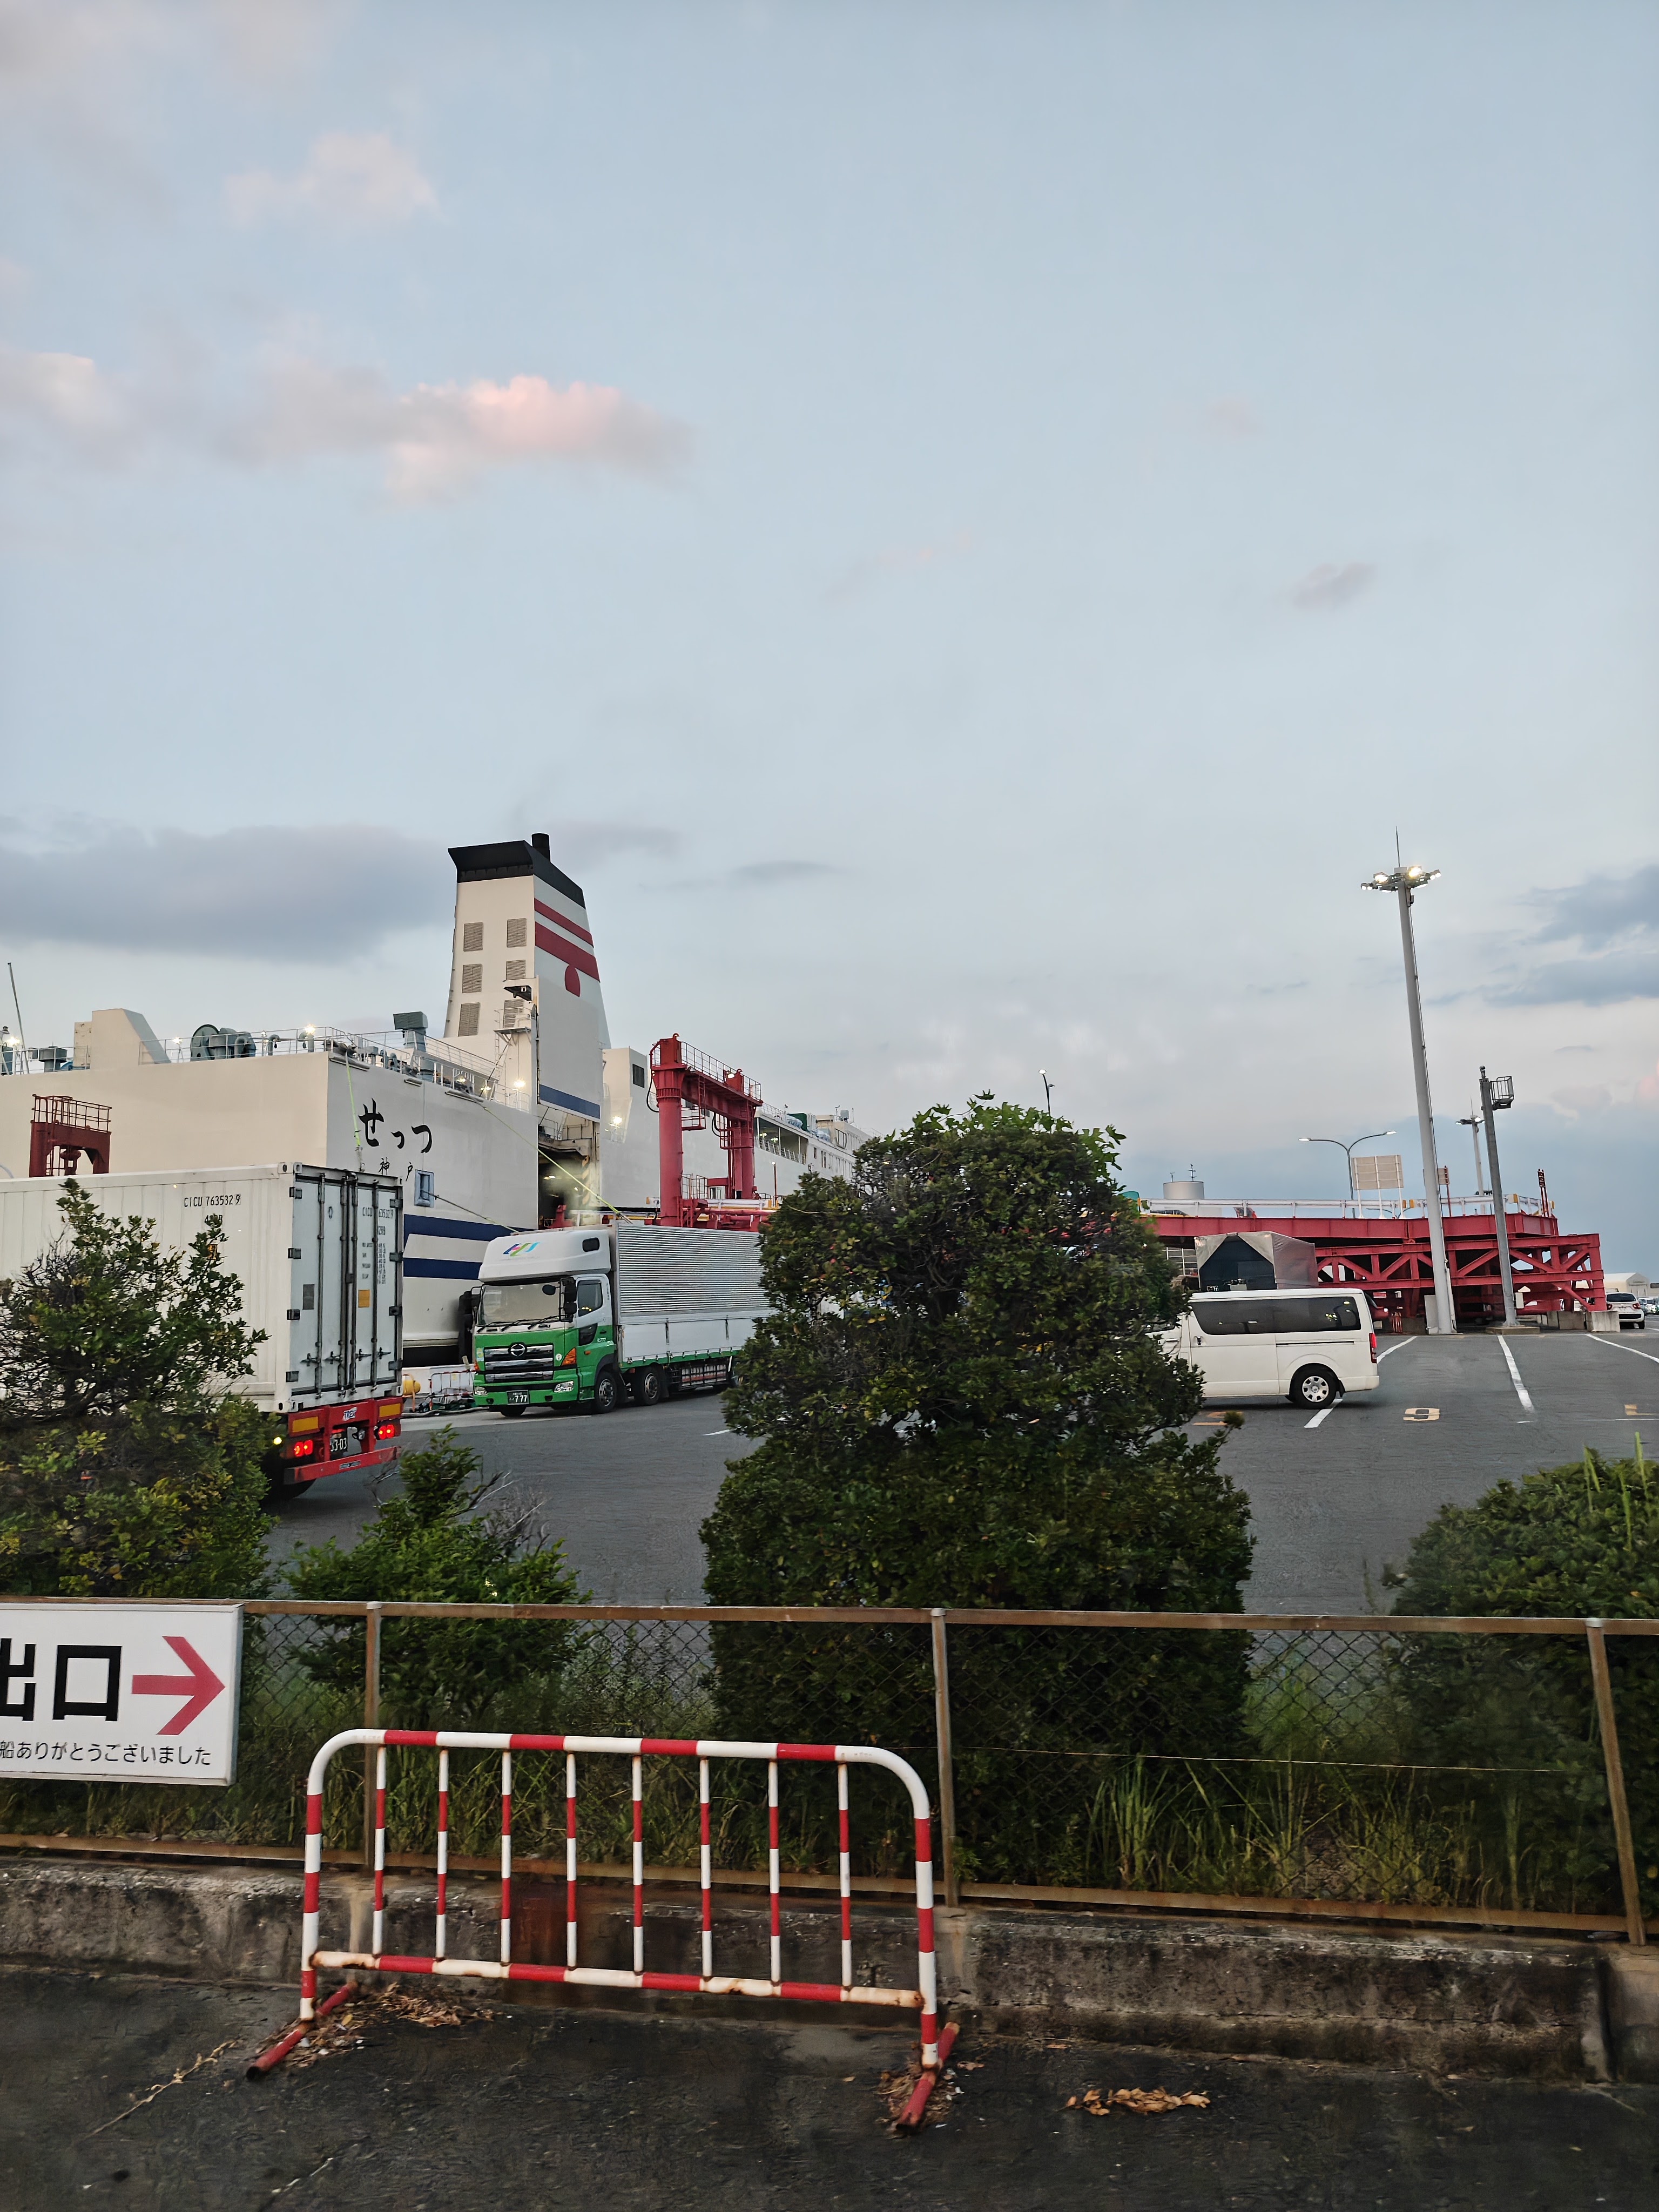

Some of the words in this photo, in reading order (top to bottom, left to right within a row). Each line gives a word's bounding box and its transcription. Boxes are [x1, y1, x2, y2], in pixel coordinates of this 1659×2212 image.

[358, 1098, 432, 1154] せっつ
[184, 1197, 203, 1208] CICU
